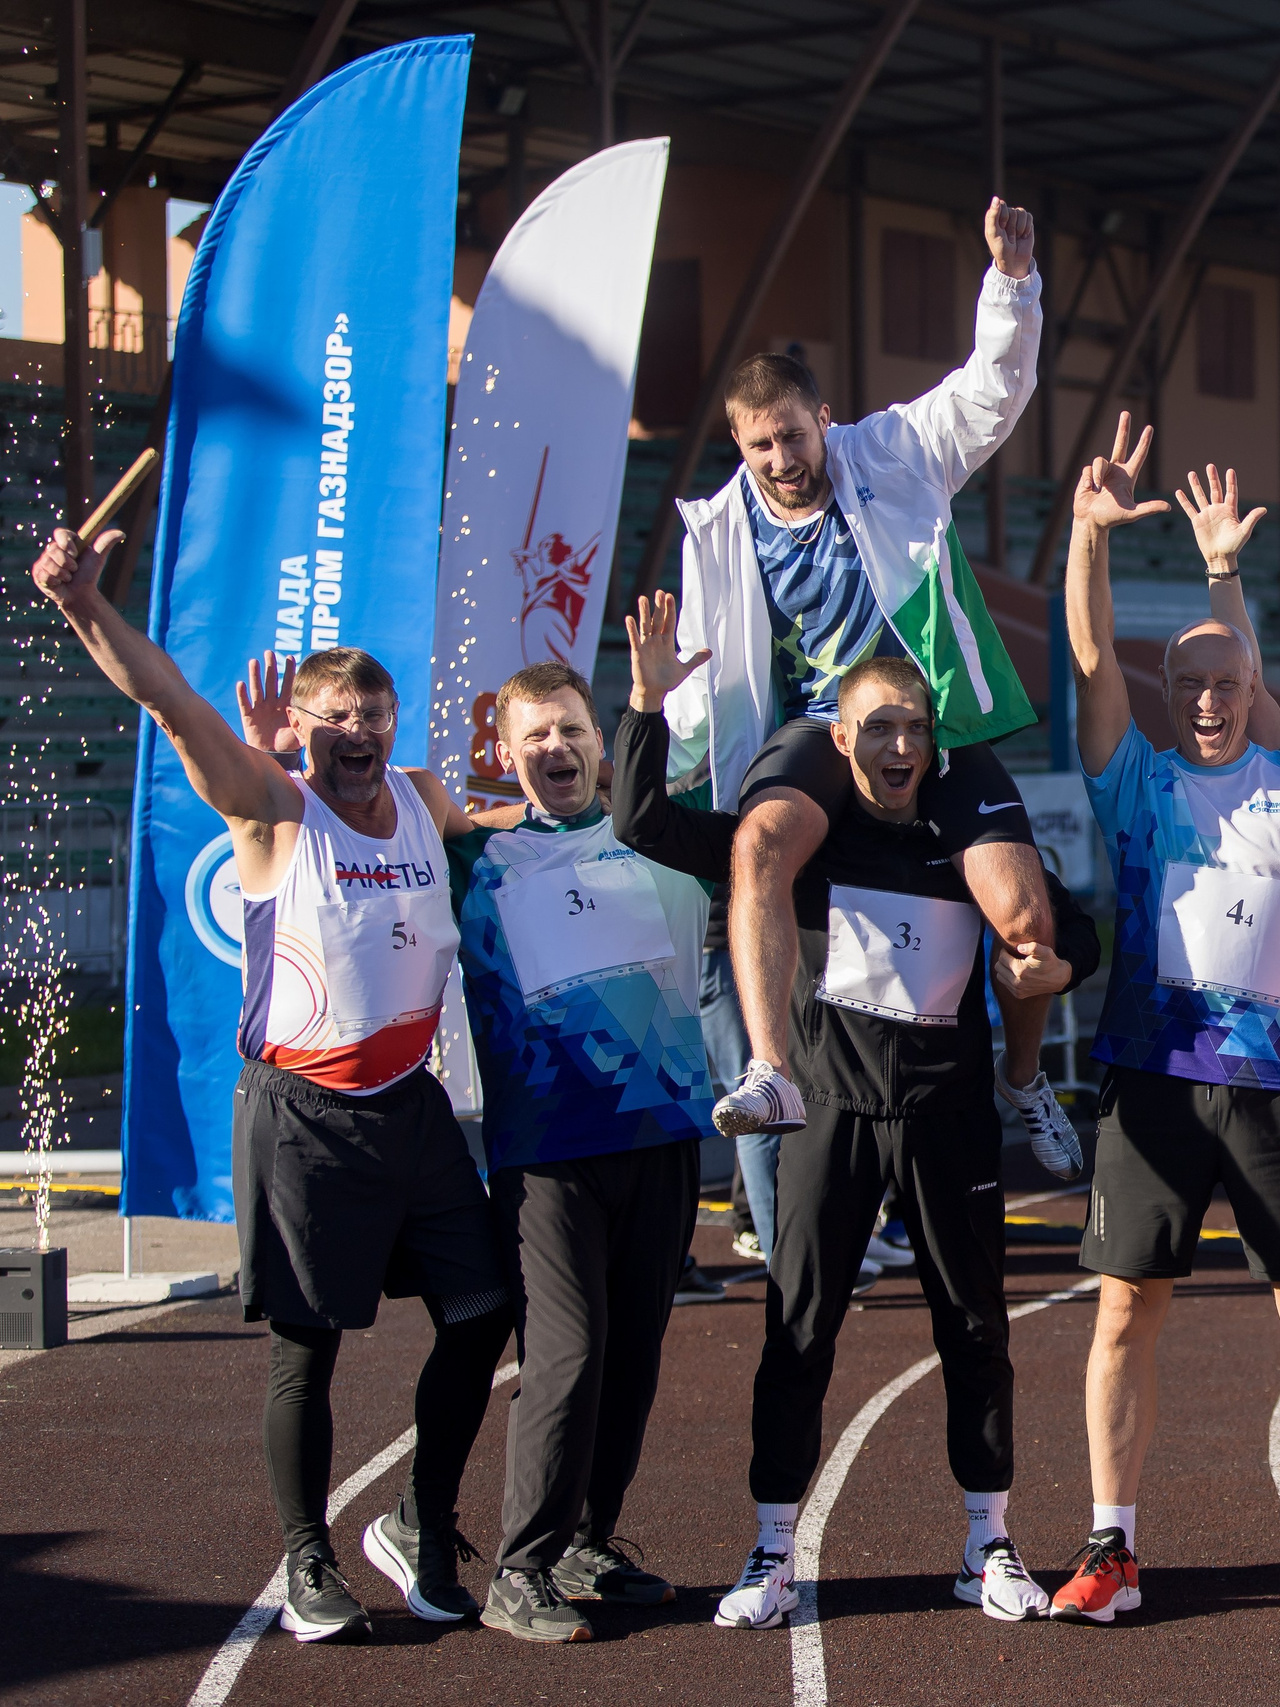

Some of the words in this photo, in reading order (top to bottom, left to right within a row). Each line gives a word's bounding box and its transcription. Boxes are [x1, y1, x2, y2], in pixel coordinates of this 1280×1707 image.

[317, 312, 356, 539] ГАЗНАДЗОР»
[310, 549, 344, 650] ПРОМ
[470, 692, 504, 780] 8
